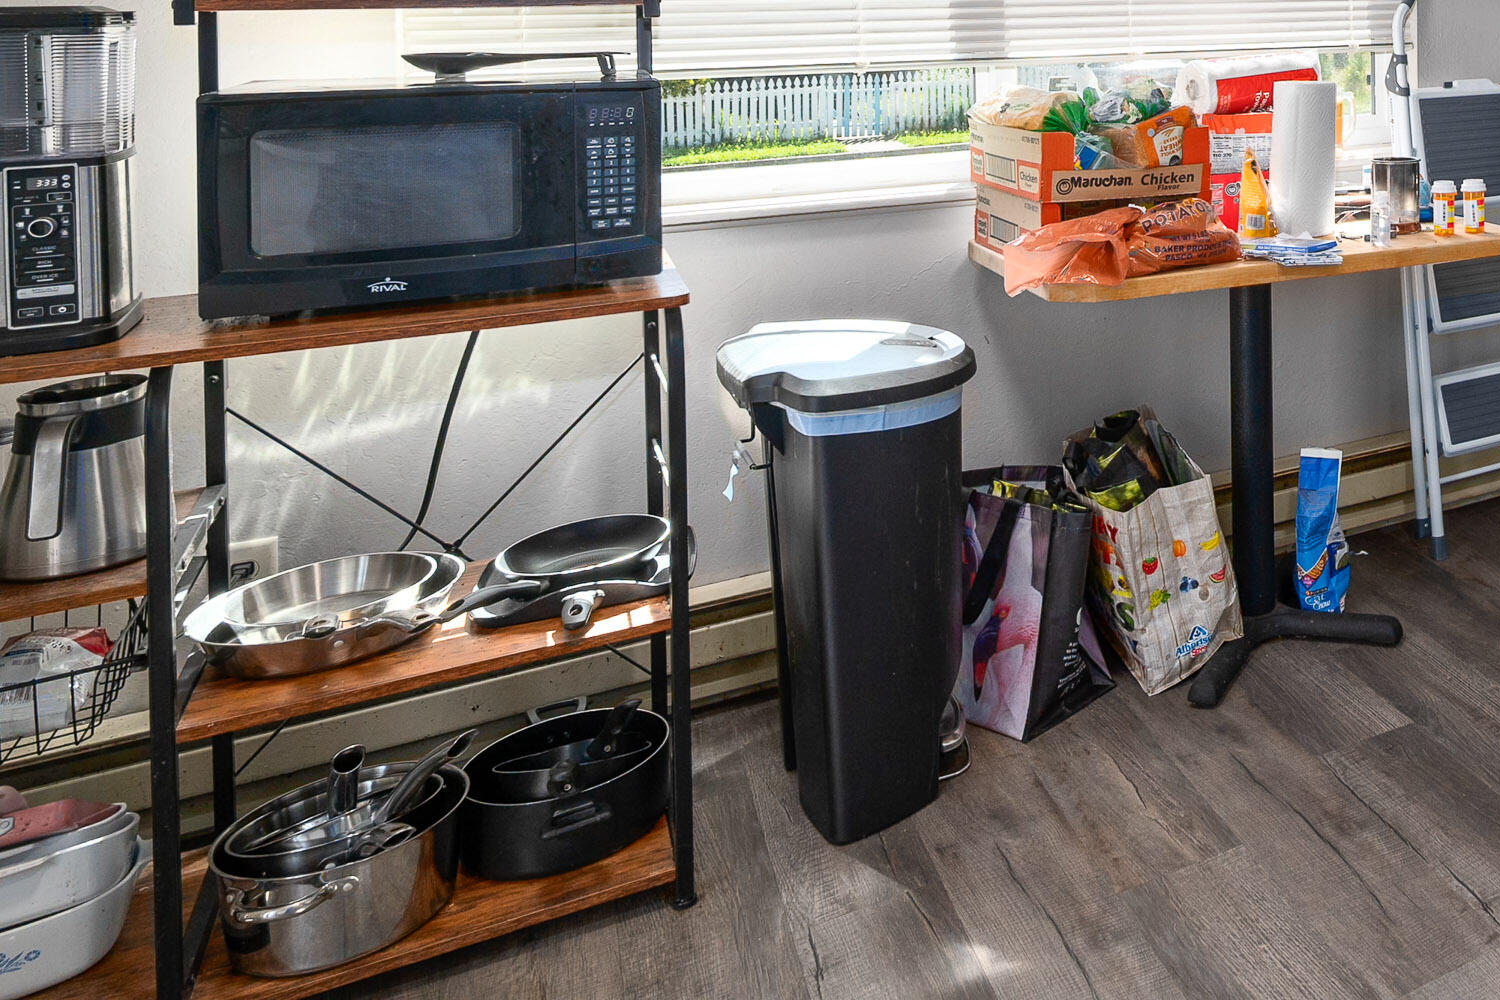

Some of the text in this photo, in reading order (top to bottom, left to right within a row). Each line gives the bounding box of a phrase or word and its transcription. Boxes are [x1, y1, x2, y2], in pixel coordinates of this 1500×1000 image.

[1160, 137, 1183, 153] WHEAT
[1019, 171, 1038, 183] Chicken
[1071, 172, 1195, 188] Maruchan Chicken
[1154, 245, 1185, 253] BAKER
[370, 282, 407, 293] RIVAL
